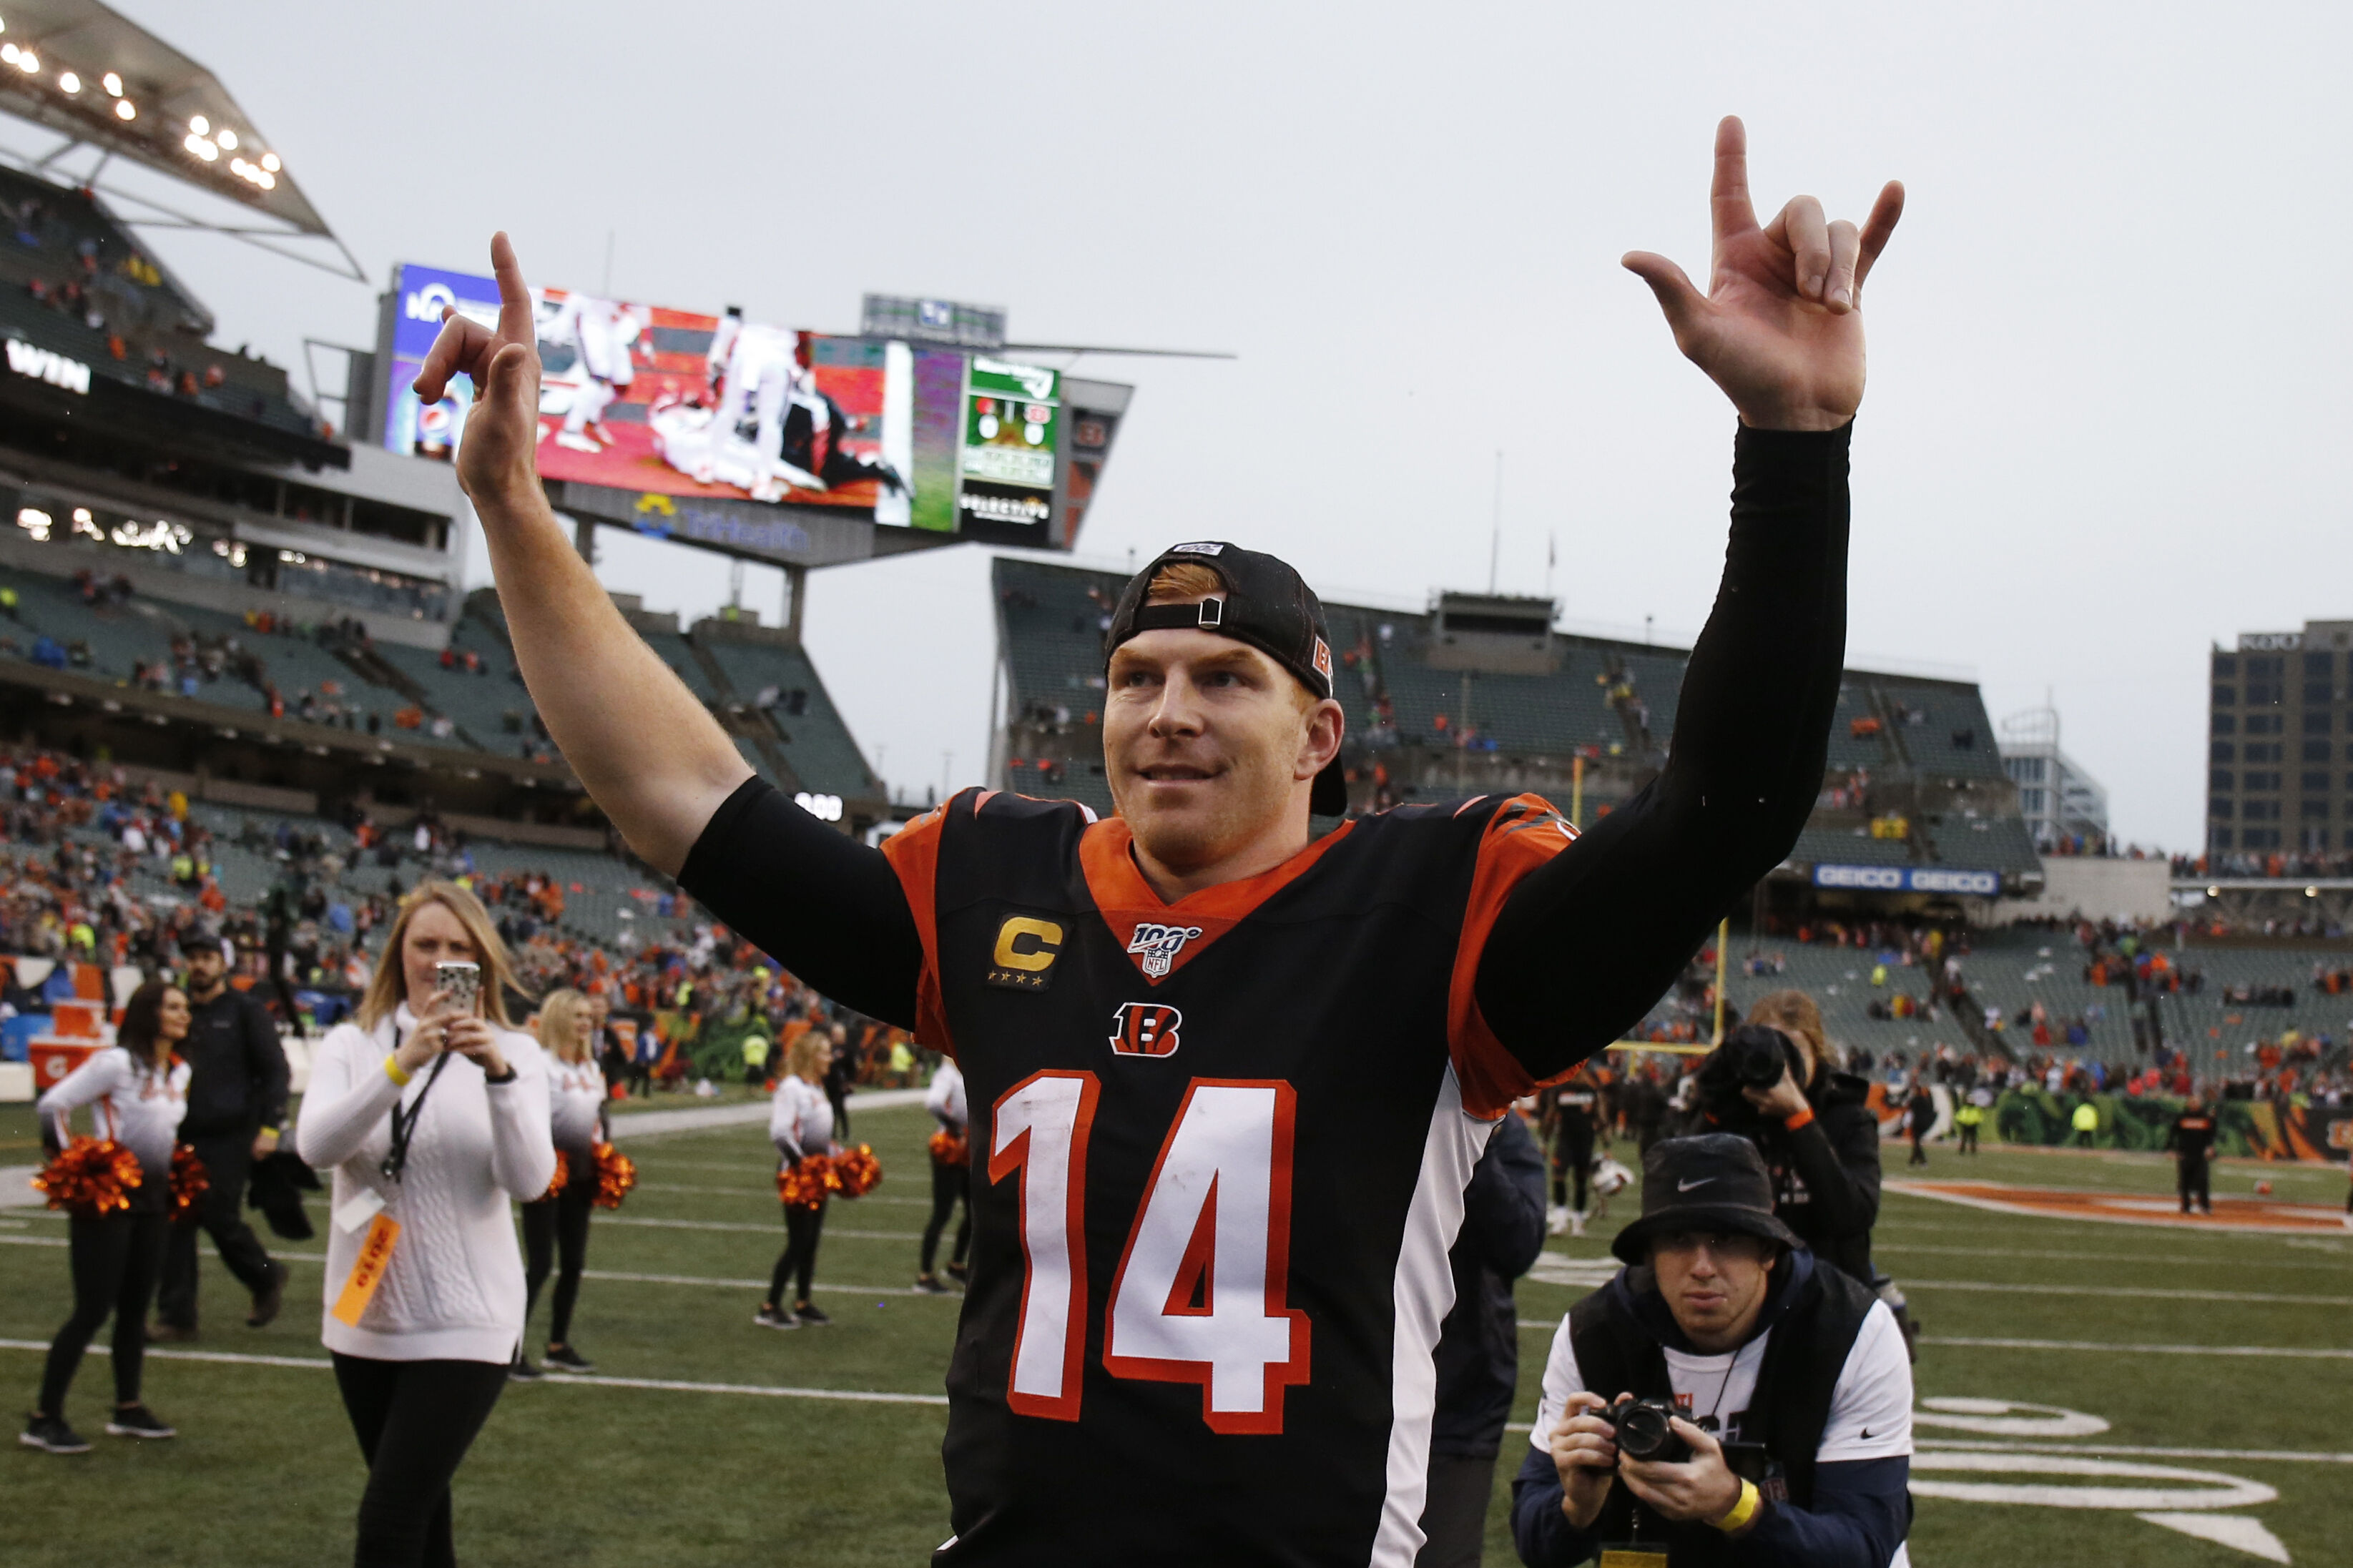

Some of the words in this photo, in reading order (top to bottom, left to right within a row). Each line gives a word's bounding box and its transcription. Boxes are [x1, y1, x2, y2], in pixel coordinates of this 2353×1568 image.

[6, 338, 92, 395] WIN
[1818, 865, 1900, 888] GEICO
[1910, 869, 1995, 893] GEICO
[993, 917, 1063, 972] C
[1147, 958, 1165, 972] NFL
[1109, 1002, 1182, 1057] B
[988, 1068, 1312, 1434] 14
